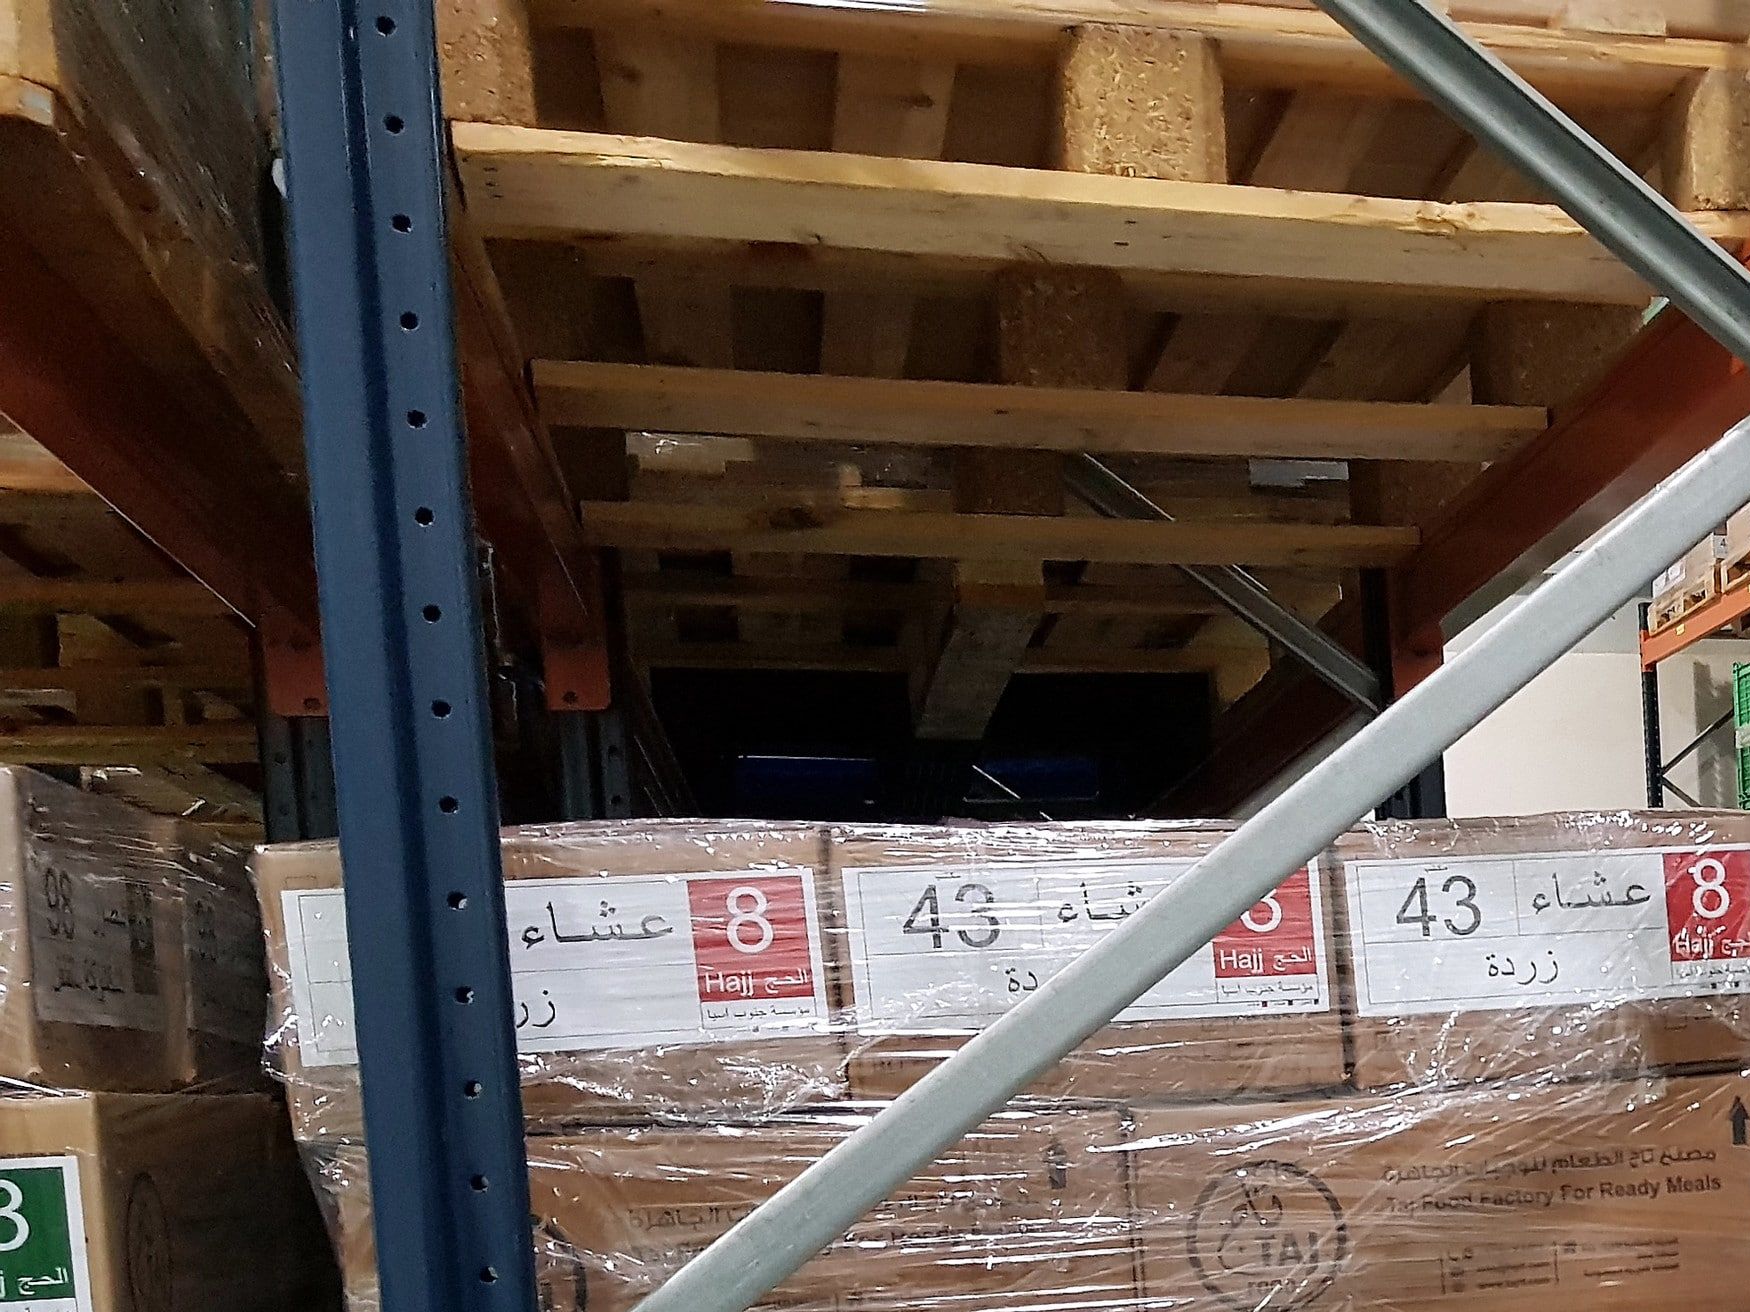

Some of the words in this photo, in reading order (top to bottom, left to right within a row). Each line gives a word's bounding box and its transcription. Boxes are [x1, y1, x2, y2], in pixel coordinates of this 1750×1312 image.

[1532, 871, 1652, 916] عشاء
[1688, 857, 1730, 920] 8
[726, 886, 774, 953] 8
[902, 883, 1001, 949] 43
[1395, 873, 1483, 938] 43
[521, 900, 674, 949] عشاء
[1220, 948, 1264, 976] Hajj
[1273, 947, 1313, 974] الحج
[1487, 949, 1560, 986] زردة
[705, 971, 754, 997] Hajj
[764, 968, 809, 994] الحج
[1007, 967, 1039, 994] دة
[1658, 1148, 1717, 1166] مصنع
[1560, 1185, 1595, 1202] For
[1600, 1178, 1660, 1199] Ready
[1667, 1174, 1723, 1194] Meals
[1254, 1231, 1320, 1275] TAJ
[18, 1267, 70, 1295] الحج
